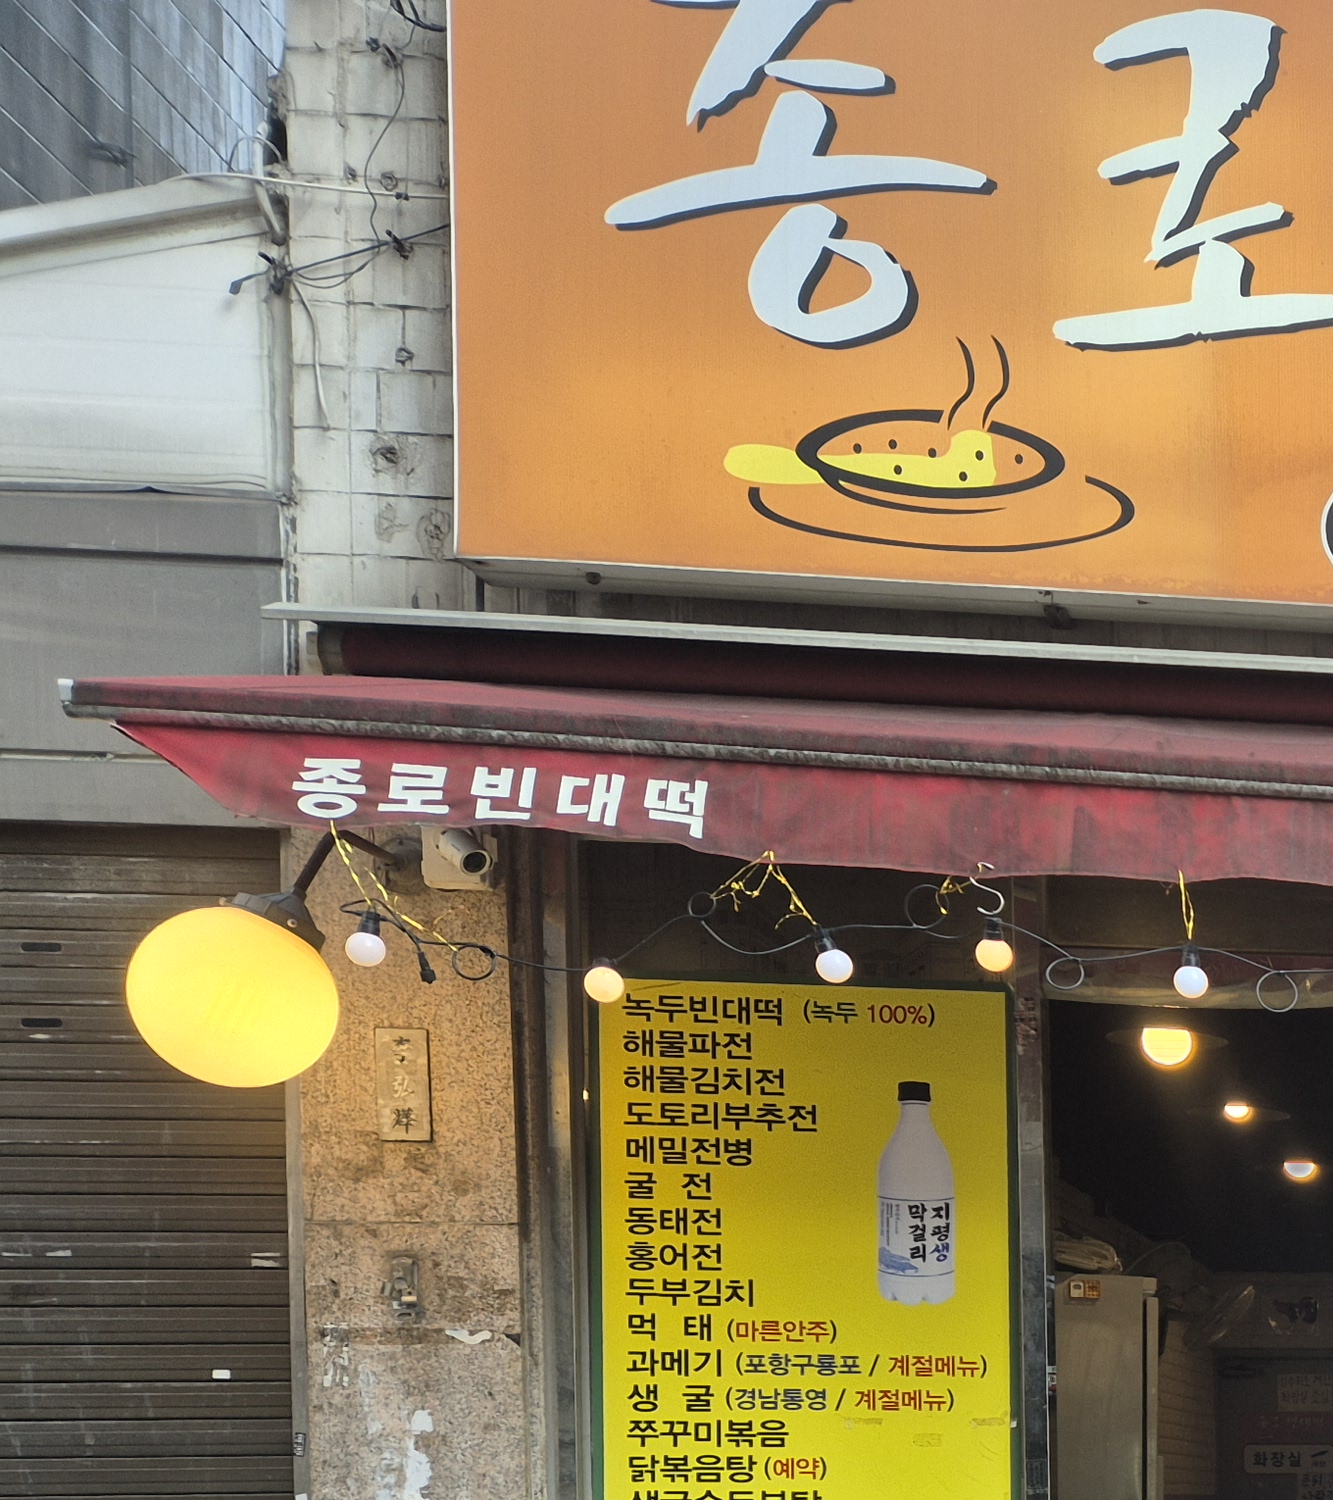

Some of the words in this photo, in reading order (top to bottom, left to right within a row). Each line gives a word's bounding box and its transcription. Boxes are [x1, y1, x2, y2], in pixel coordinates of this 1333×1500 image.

[291, 757, 708, 839] 종로빈대떡
[621, 993, 784, 1026] 녹두빈대떡
[803, 999, 858, 1025] (녹두
[866, 1002, 935, 1026] 100%)
[622, 1029, 754, 1060] 해물파전
[622, 1065, 786, 1097] 해물김치전
[623, 1100, 818, 1133] 도토리부추전
[625, 1136, 754, 1166] 메밀전병
[624, 1208, 723, 1236] 동태전
[625, 1242, 723, 1272] 홍어전
[625, 1278, 755, 1307] 두부김치
[727, 1318, 838, 1344] (마른안주)
[626, 1349, 722, 1377] 과메기
[626, 1420, 789, 1449] 쭈꾸미볶음
[628, 1455, 756, 1483] 닭볶음탕
[764, 1457, 827, 1481] (예약)
[1253, 1451, 1301, 1467] 화장실
